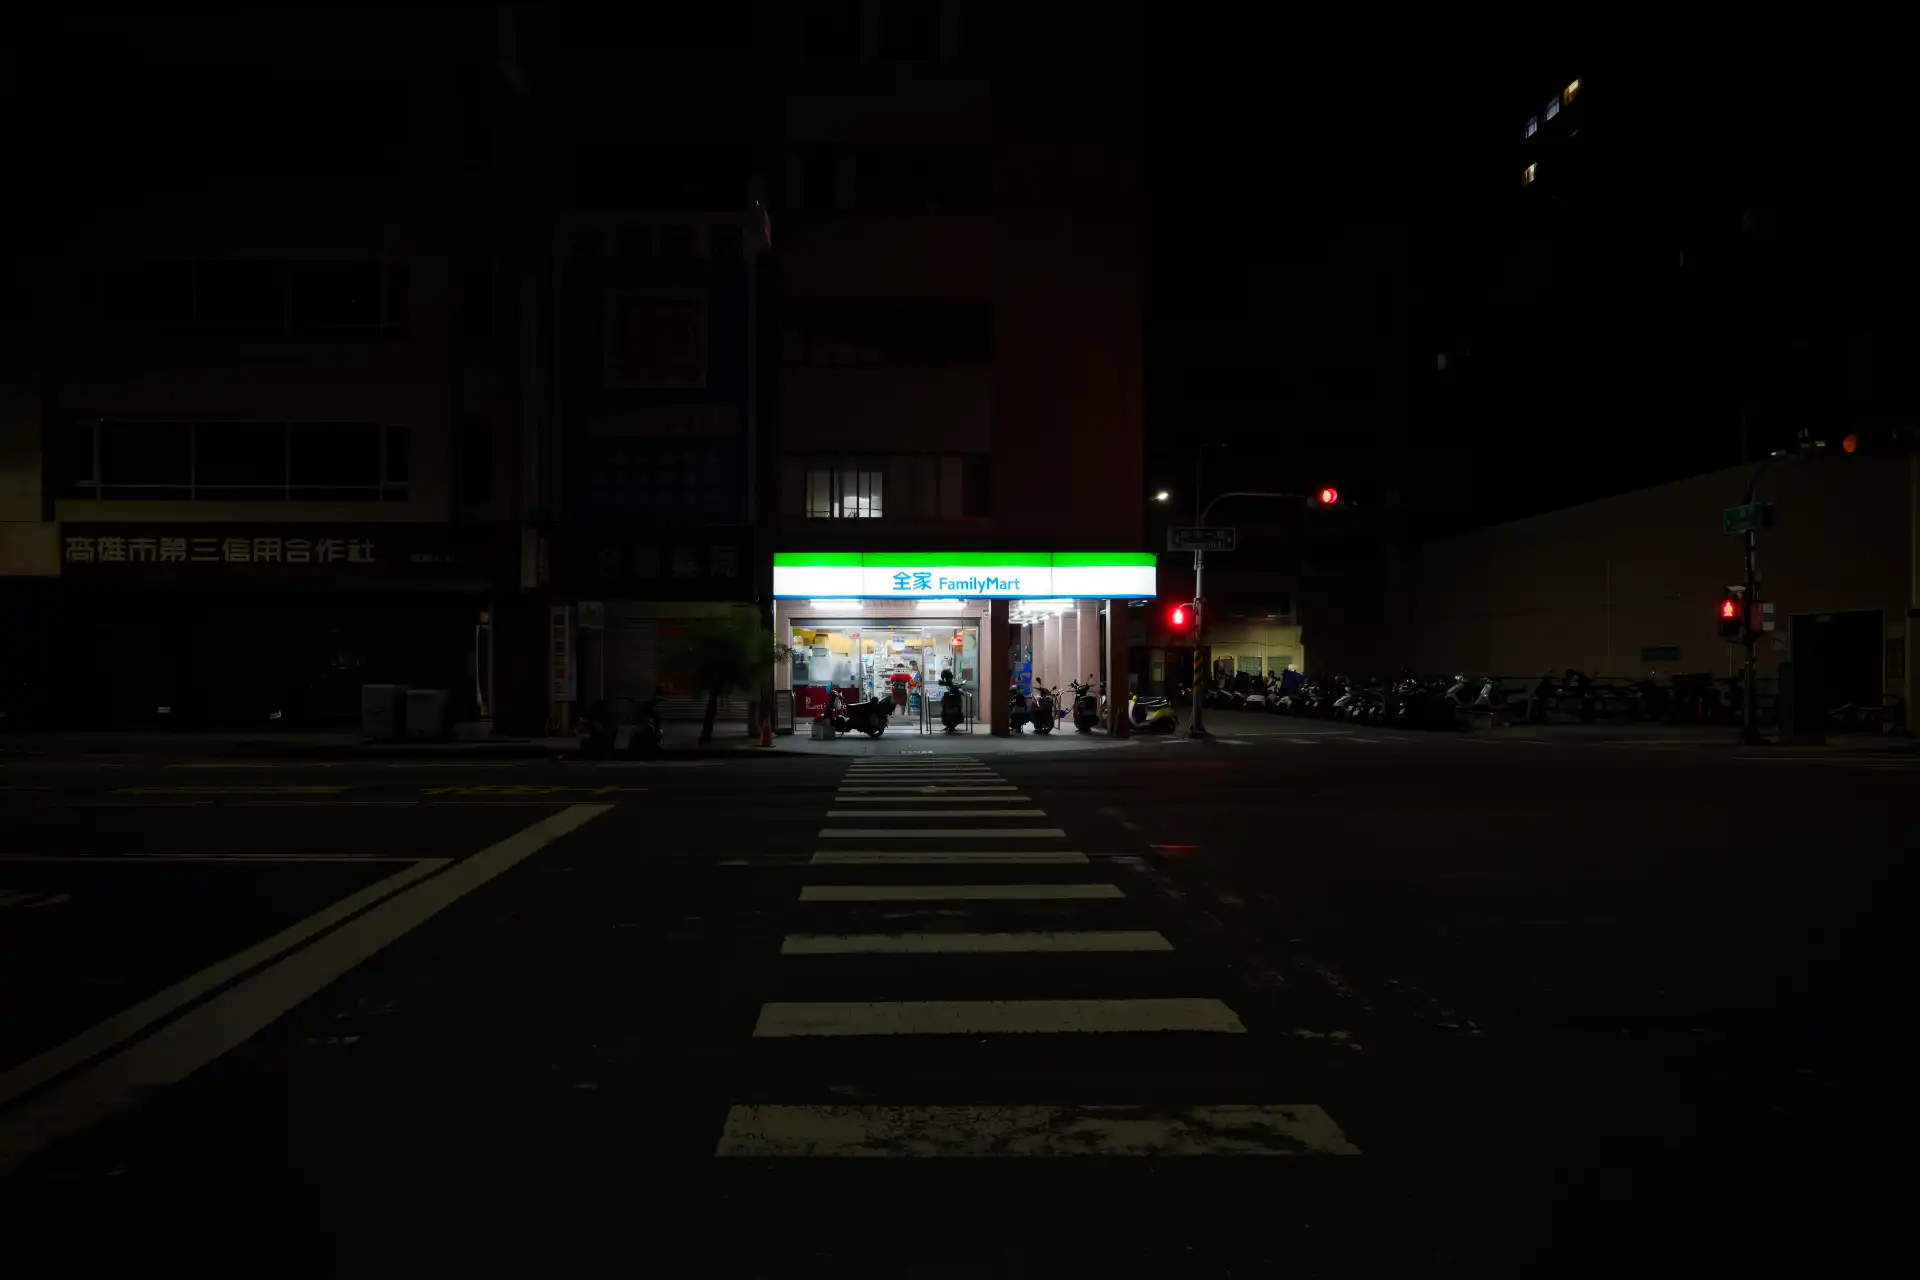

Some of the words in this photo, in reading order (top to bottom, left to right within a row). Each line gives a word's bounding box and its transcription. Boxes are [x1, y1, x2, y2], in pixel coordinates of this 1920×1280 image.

[65, 536, 377, 563] 高雄市第三信用合作社
[893, 571, 932, 590] 全家
[939, 577, 1020, 593] FamilyMart
